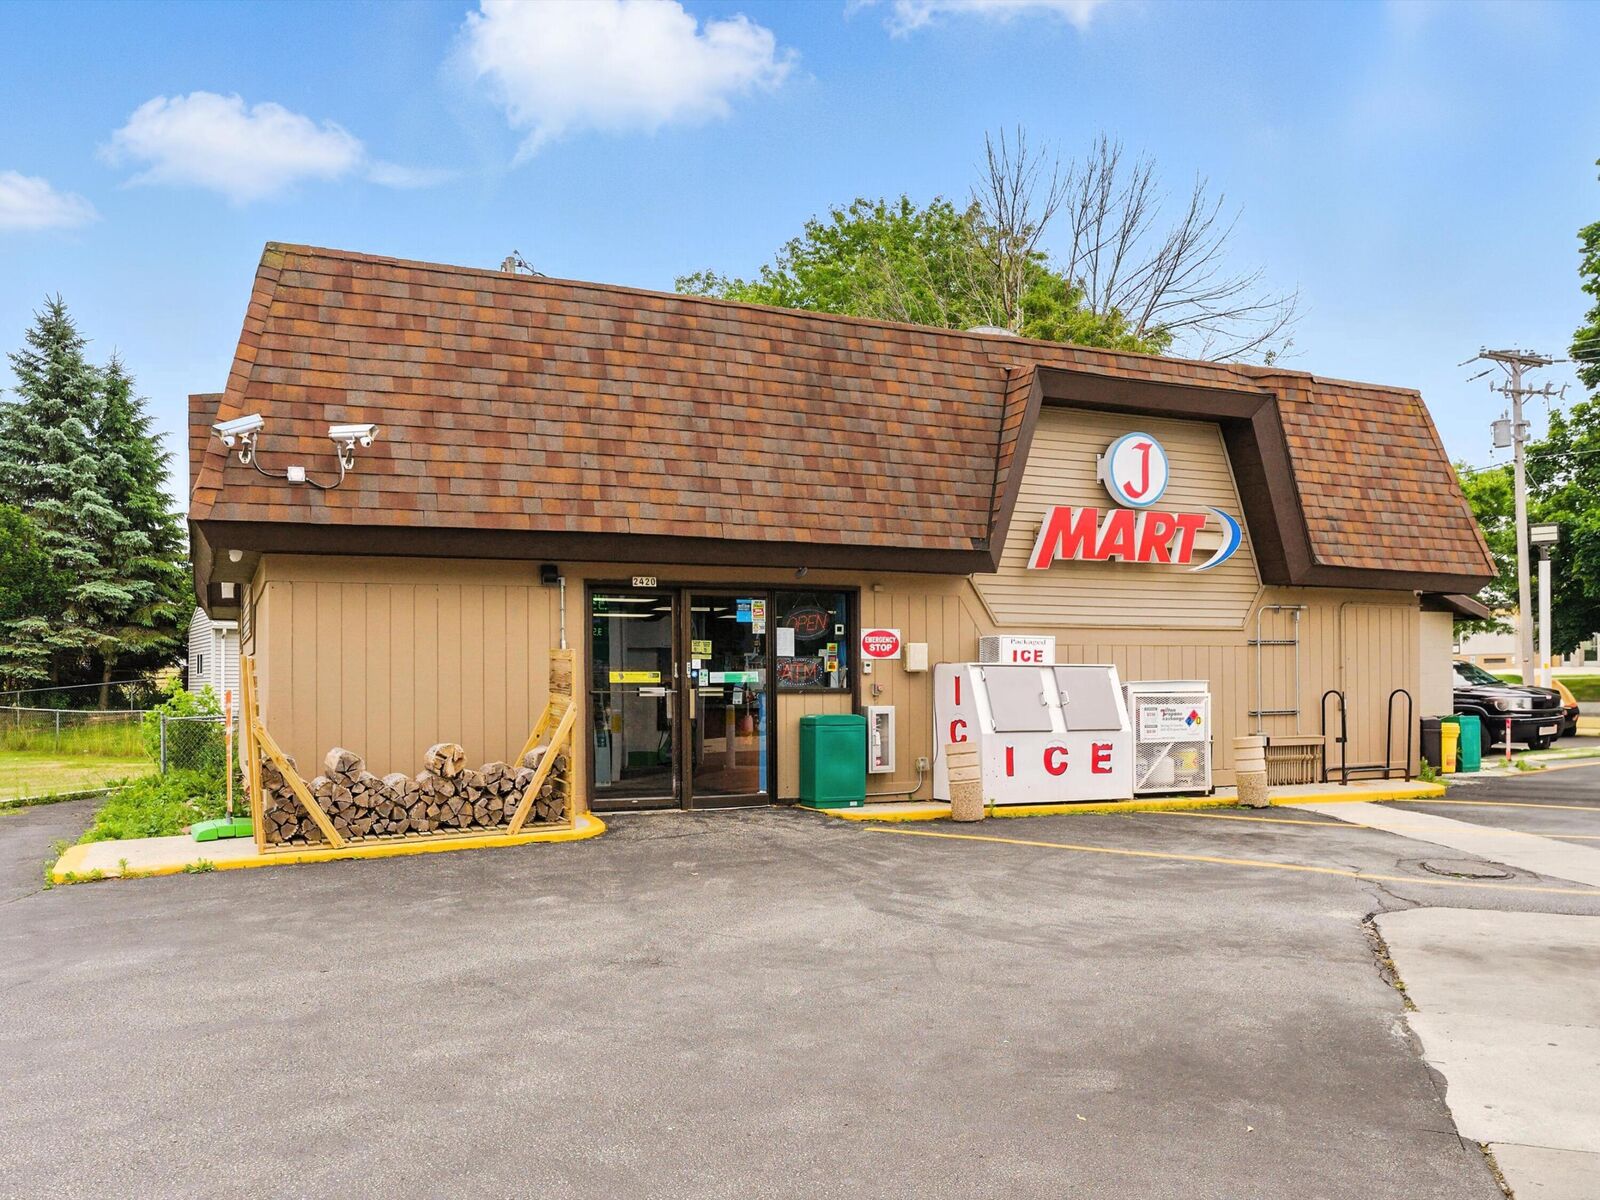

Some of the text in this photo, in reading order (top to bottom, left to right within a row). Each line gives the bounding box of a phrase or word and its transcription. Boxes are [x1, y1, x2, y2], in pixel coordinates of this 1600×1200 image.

[1123, 442, 1153, 499] J
[1029, 505, 1207, 570] MART
[633, 577, 656, 586] 2420
[786, 613, 828, 632] OPEN
[864, 636, 897, 644] EMERGENCY
[869, 643, 893, 652] STOP
[1010, 638, 1046, 646] Packaged
[1012, 649, 1044, 663] ICE
[781, 662, 817, 684] ATM
[1005, 742, 1113, 777] ICE
